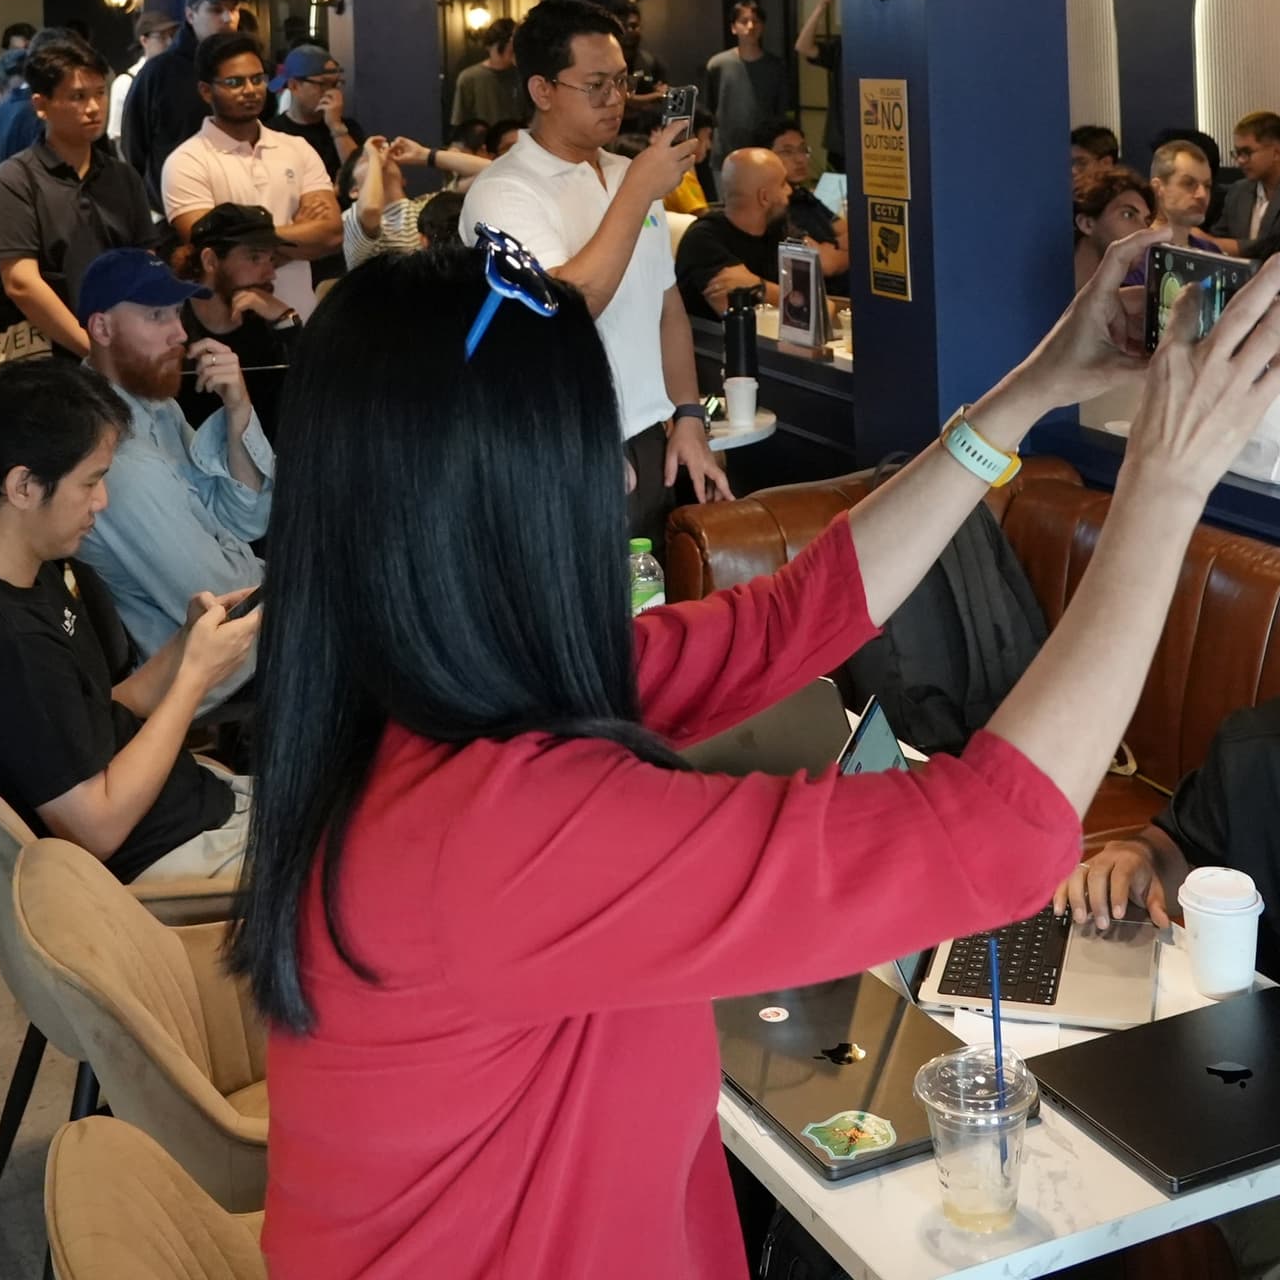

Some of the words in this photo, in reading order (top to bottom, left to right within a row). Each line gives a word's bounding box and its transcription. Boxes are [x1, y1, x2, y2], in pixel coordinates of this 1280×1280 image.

[881, 102, 903, 131] NO
[864, 133, 905, 152] OUTSIDE
[874, 204, 900, 217] CCTV
